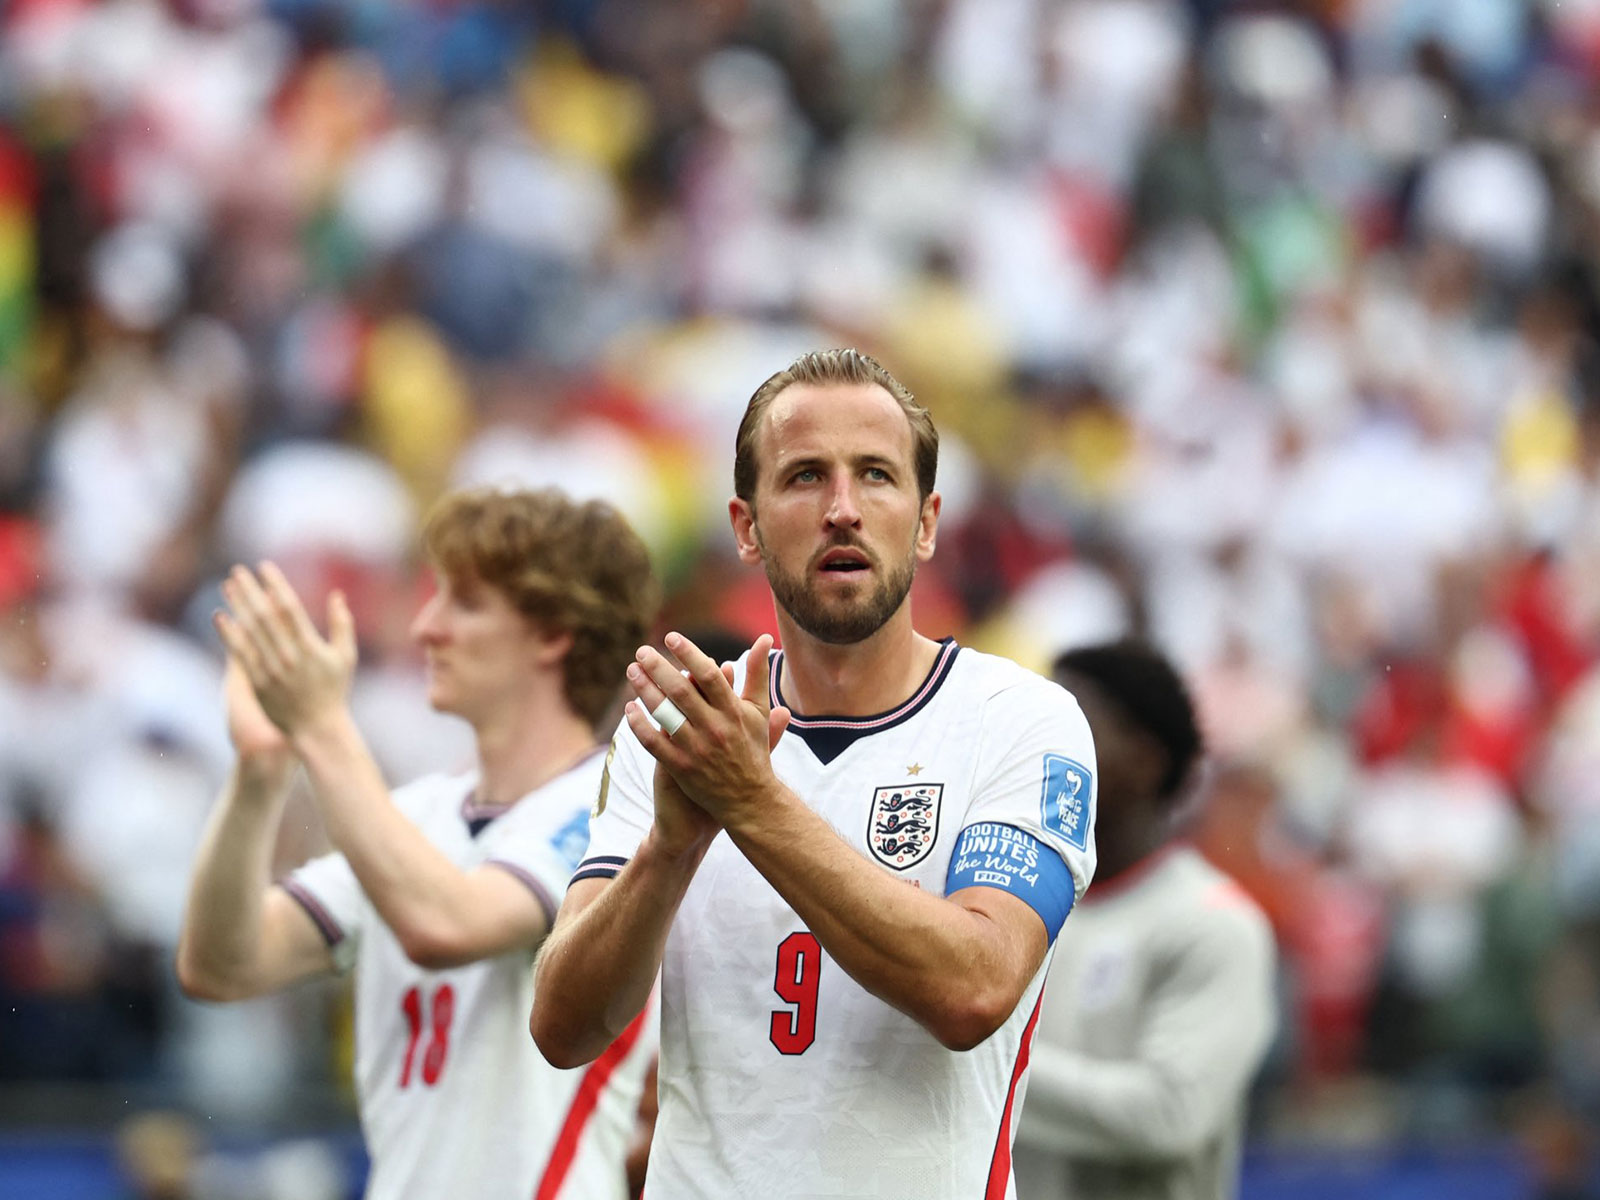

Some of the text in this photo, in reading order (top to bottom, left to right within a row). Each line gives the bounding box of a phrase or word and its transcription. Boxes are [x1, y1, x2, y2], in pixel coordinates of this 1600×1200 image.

[961, 837, 1039, 868] UNITES
[964, 824, 1040, 853] FOOTBALL
[954, 854, 1039, 887] the World
[974, 870, 1011, 886] FIFA
[769, 931, 822, 1056] 9
[399, 983, 455, 1088] 18
